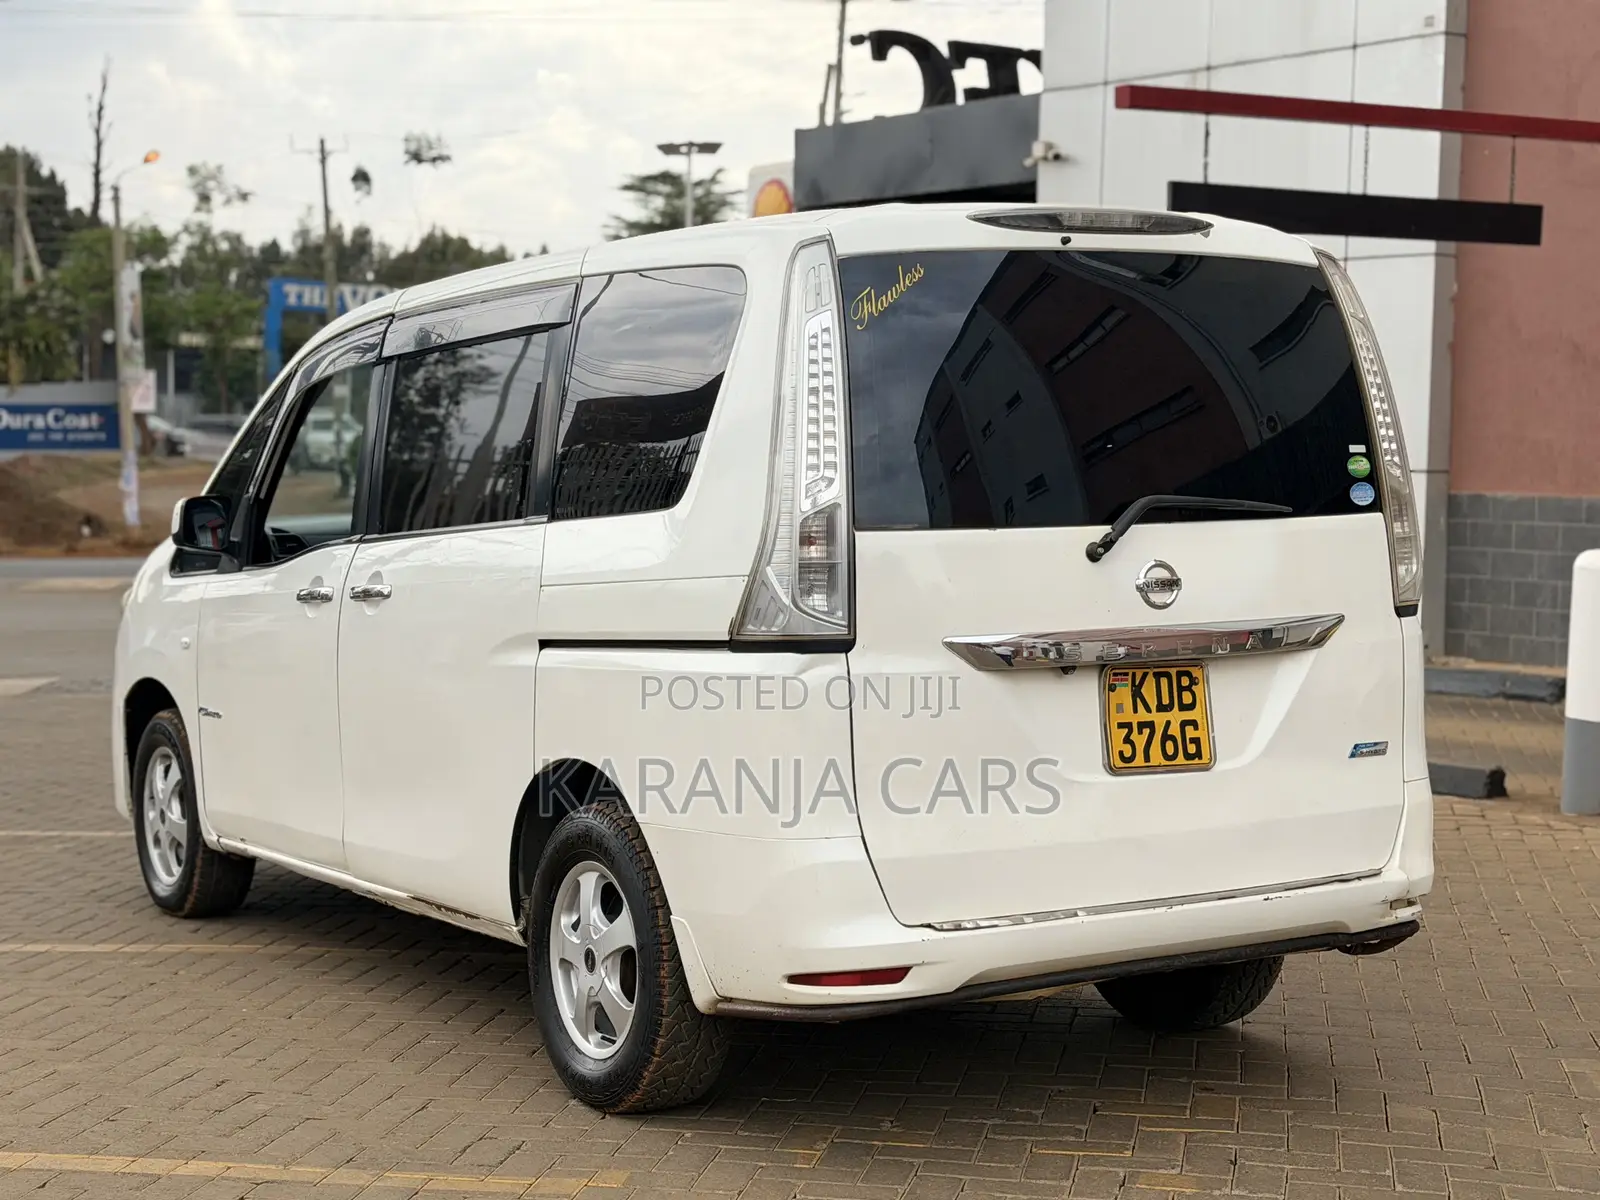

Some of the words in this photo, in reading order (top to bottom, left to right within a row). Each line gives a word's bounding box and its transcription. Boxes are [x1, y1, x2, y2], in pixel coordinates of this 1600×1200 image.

[850, 263, 924, 330] Flawless
[1142, 579, 1179, 590] NISSAN
[1062, 633, 1263, 660] SERENA
[1131, 670, 1197, 714] KDB
[1117, 719, 1203, 764] 376G
